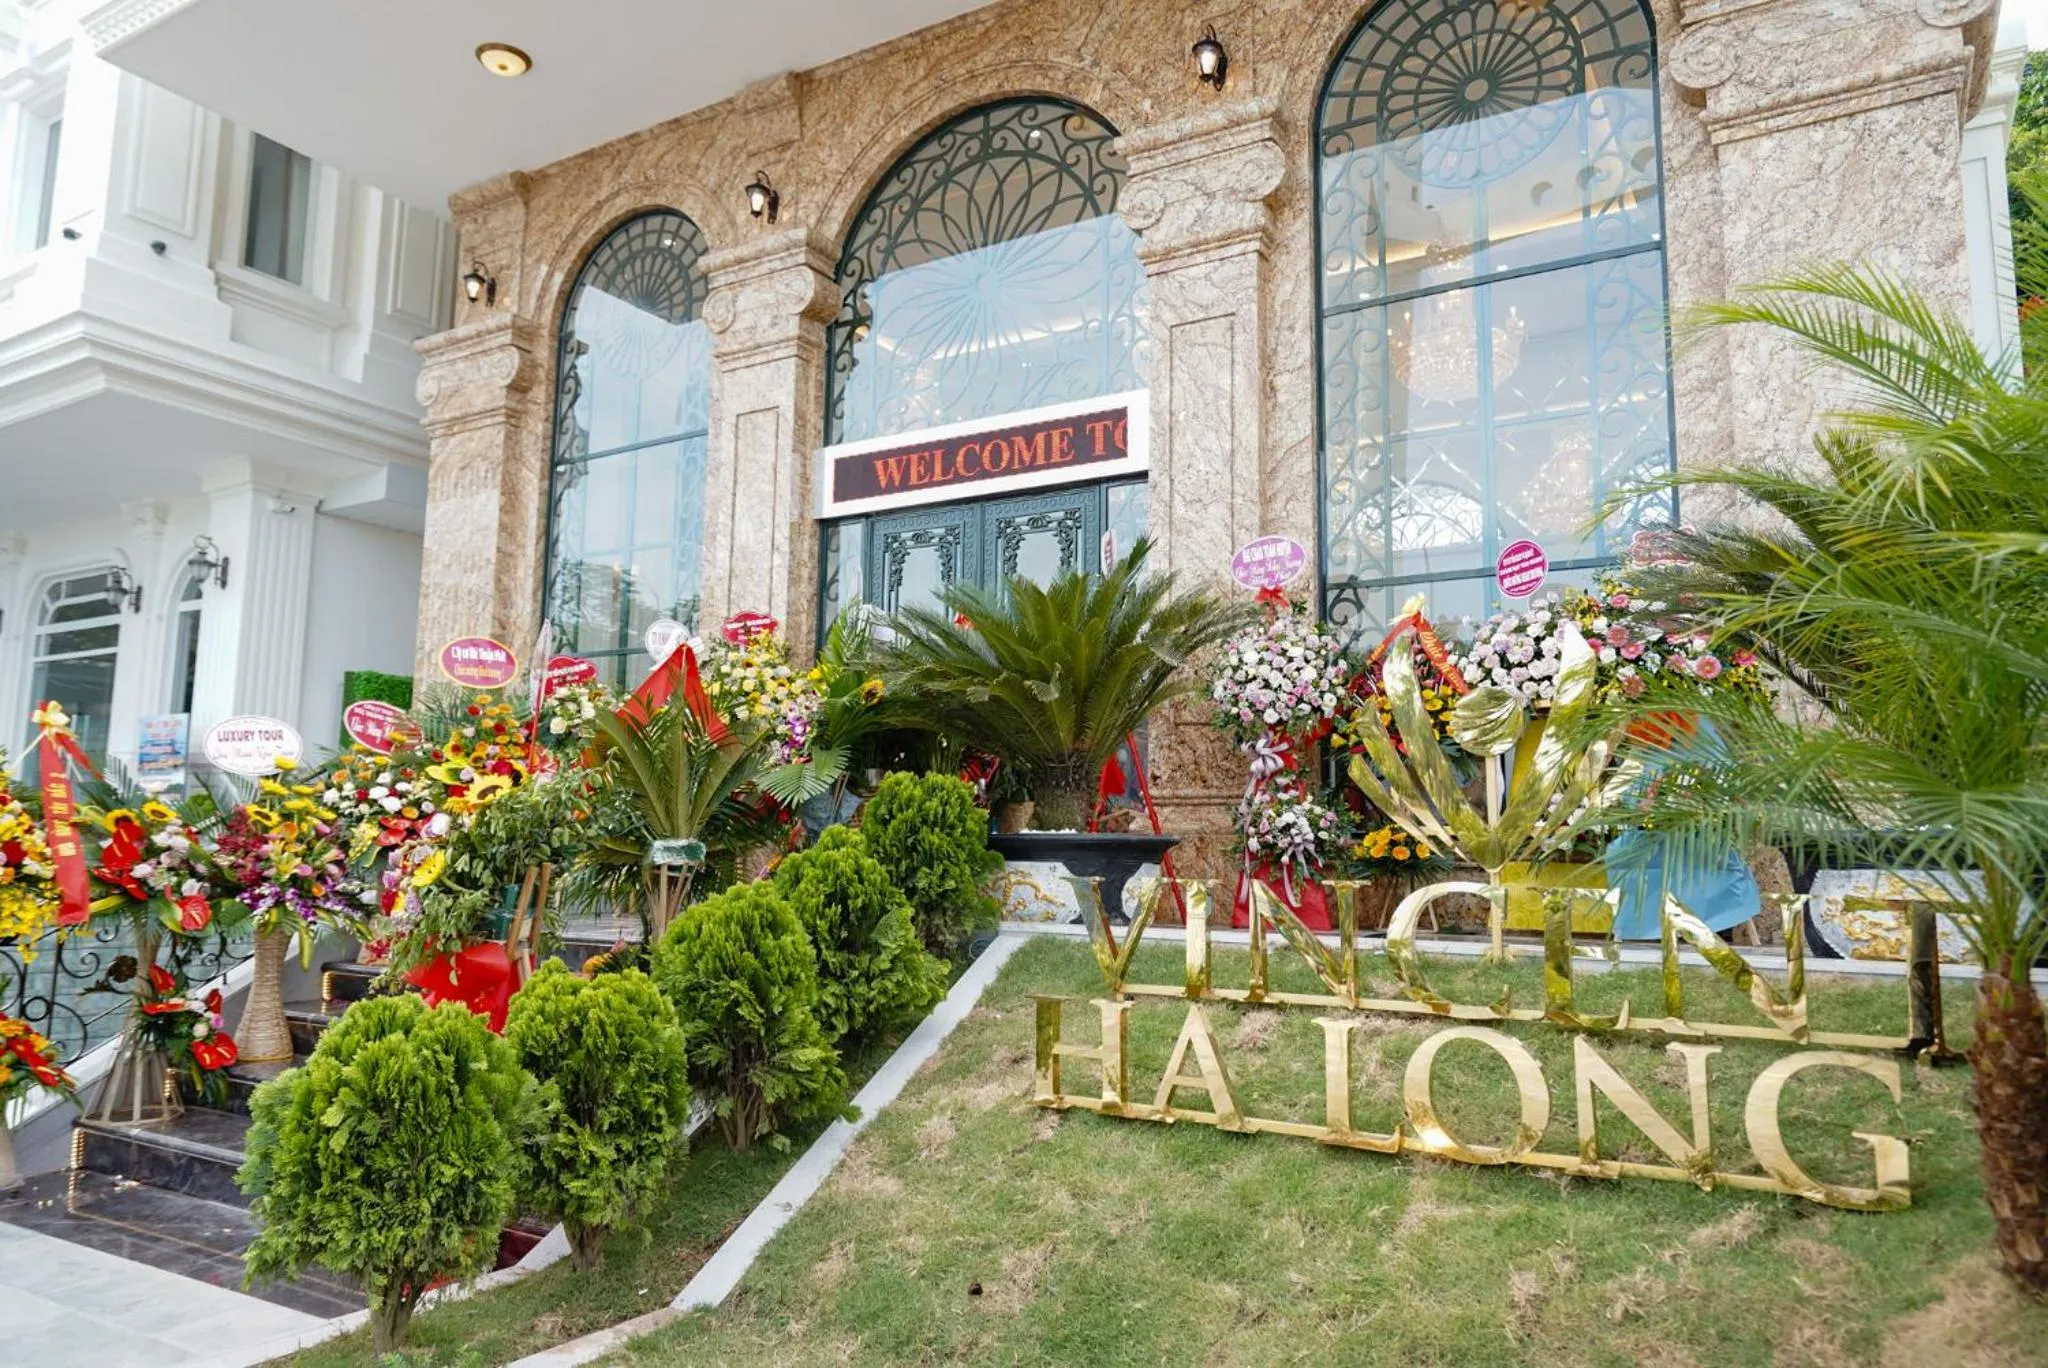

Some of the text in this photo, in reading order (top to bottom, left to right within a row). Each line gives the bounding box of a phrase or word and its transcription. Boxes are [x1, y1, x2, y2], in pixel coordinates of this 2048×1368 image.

[873, 426, 1075, 490] WELCOME
[217, 729, 284, 742] LUXURY TOUR
[1060, 875, 1972, 1062] VINCENT
[1026, 995, 1912, 1212] HA LONG
